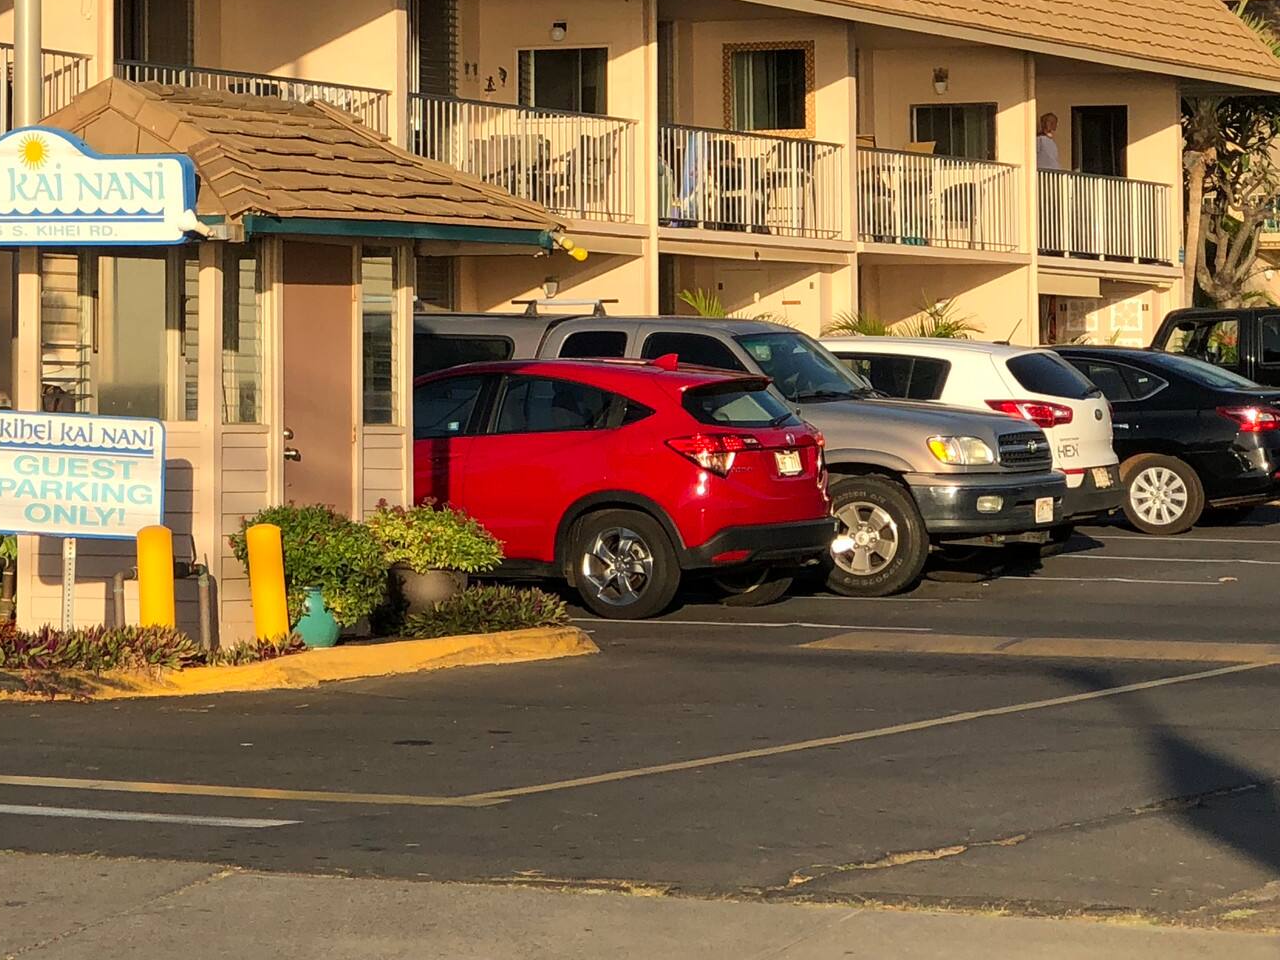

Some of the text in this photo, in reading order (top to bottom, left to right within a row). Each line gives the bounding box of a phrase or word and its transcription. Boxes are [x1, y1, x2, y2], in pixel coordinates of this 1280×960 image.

[12, 225, 29, 238] S.
[36, 224, 82, 238] KIHEI
[89, 224, 119, 238] RD.
[13, 454, 139, 481] GUEST
[24, 503, 126, 527] ONLY!
